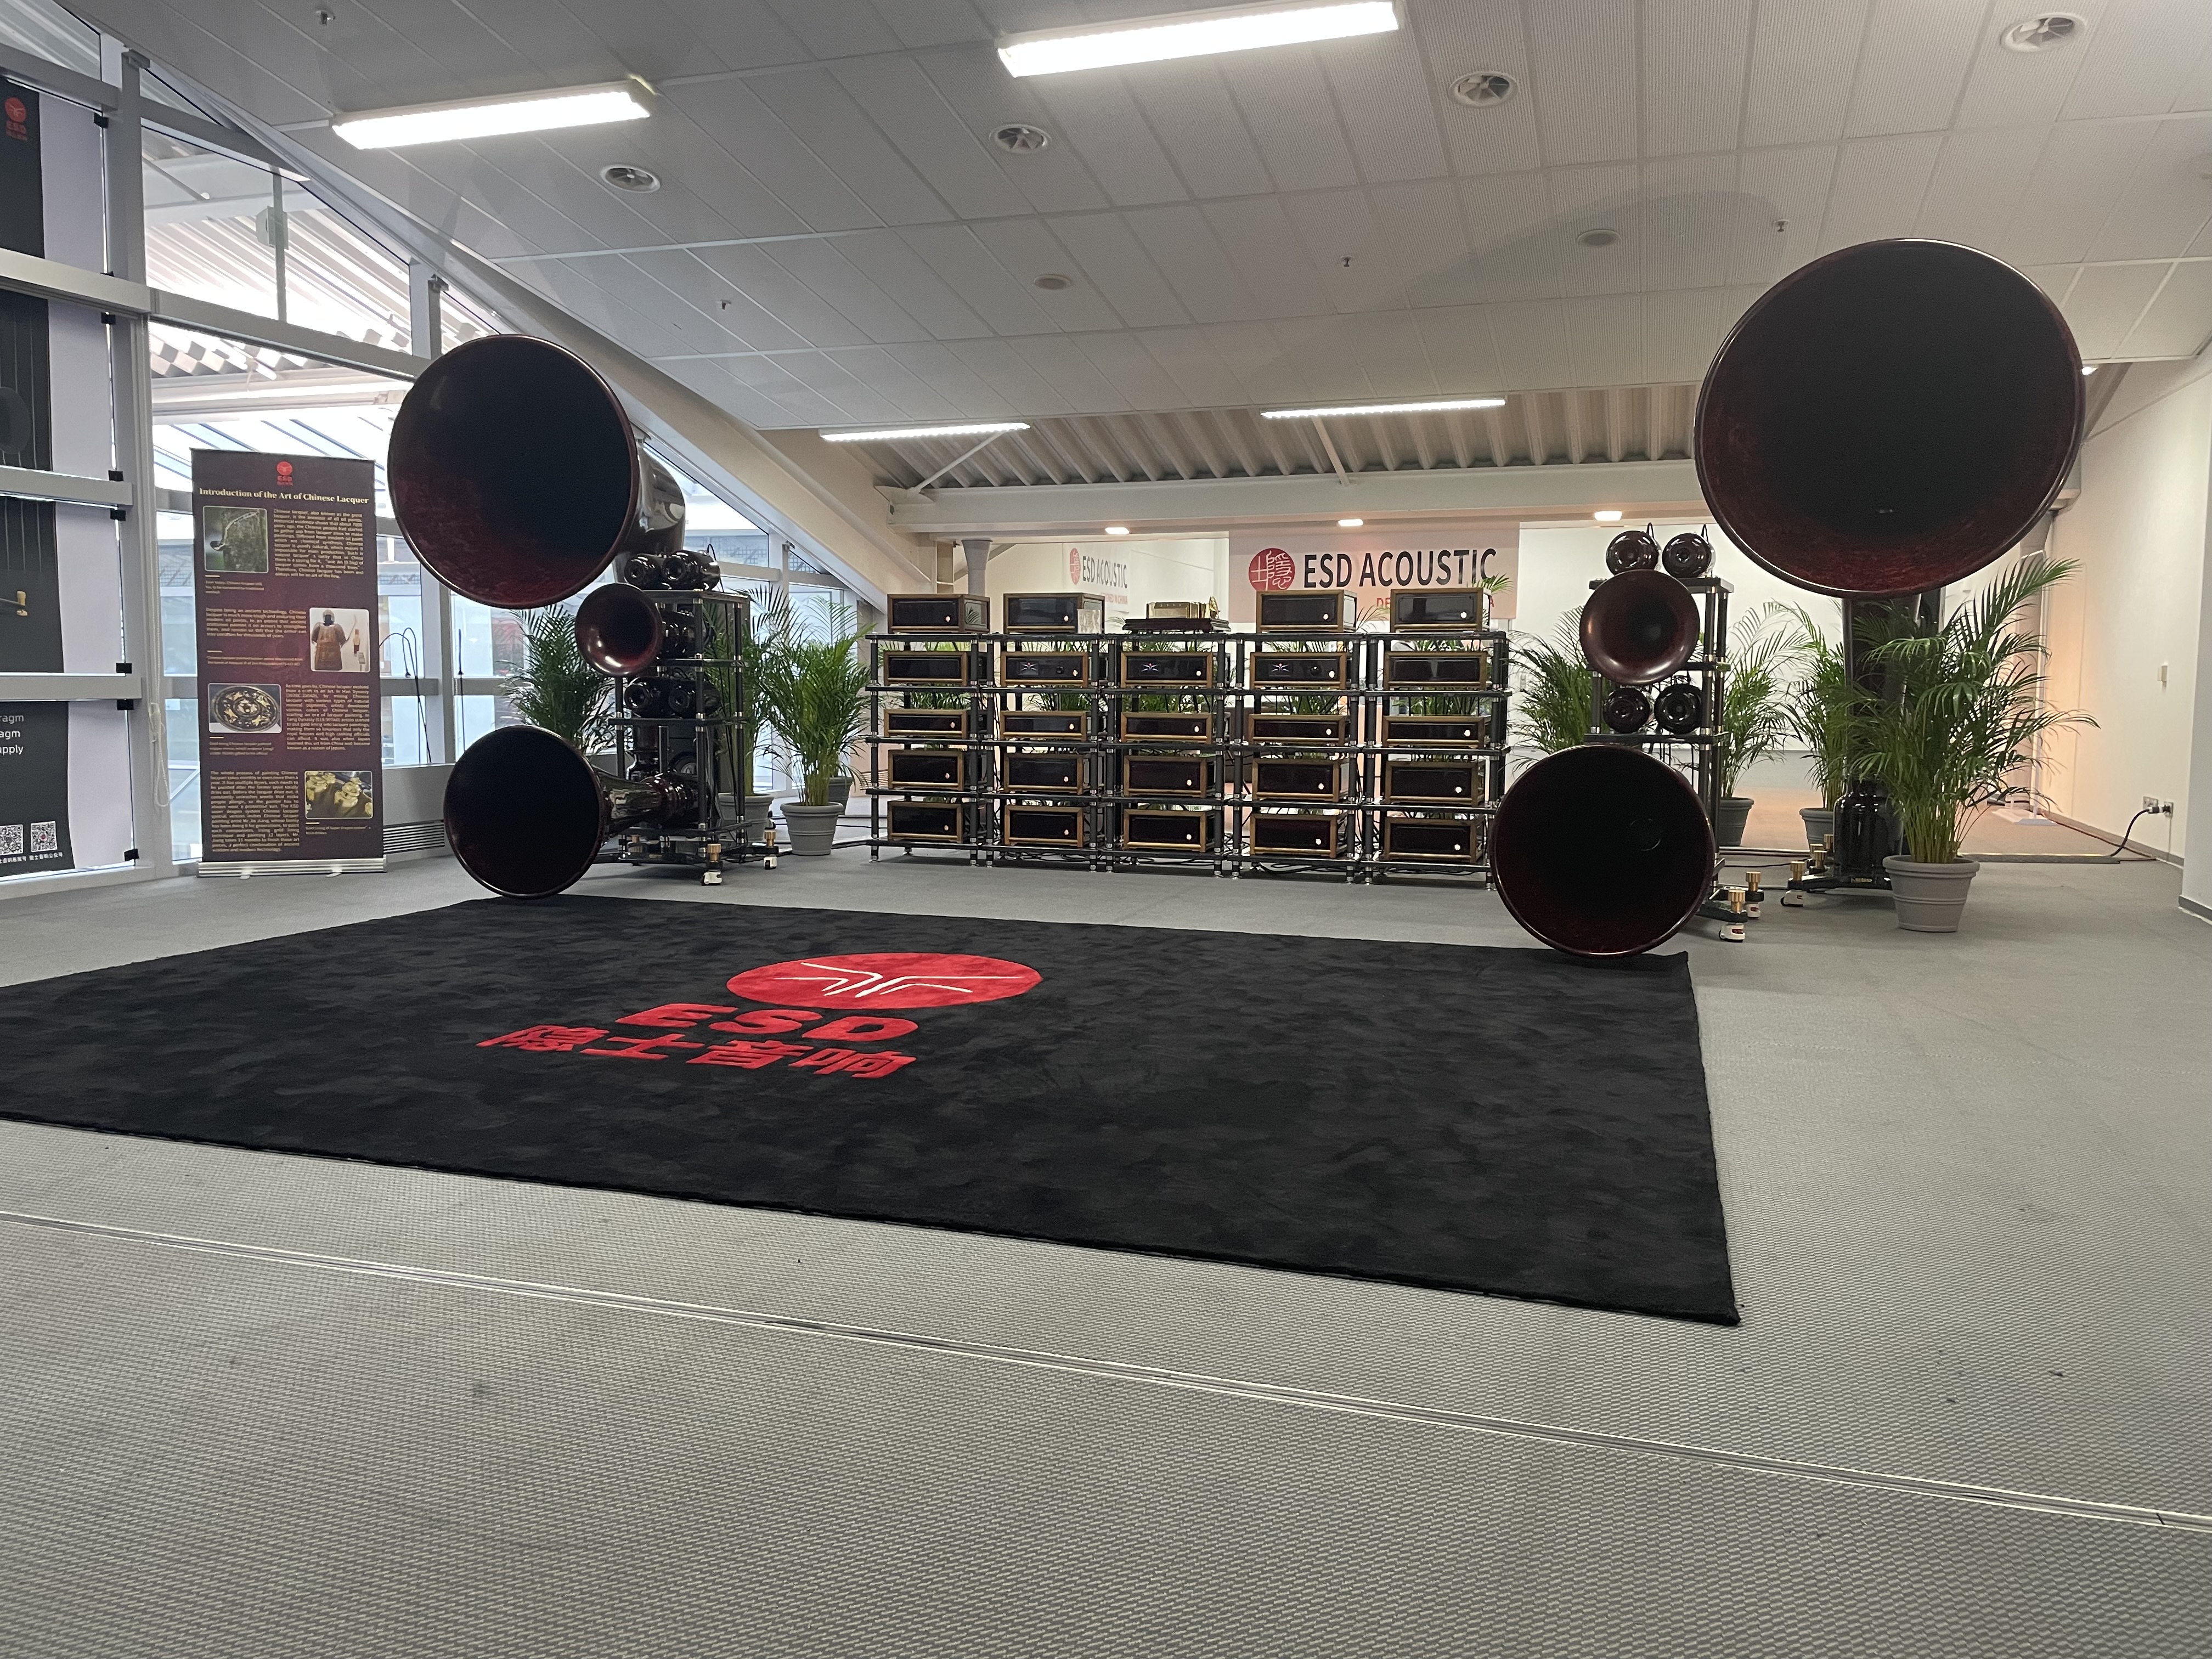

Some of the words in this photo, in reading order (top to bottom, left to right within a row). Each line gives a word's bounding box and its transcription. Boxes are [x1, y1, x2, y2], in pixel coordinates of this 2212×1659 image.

[200, 488, 252, 498] Introduction
[293, 492, 302, 500] of
[303, 493, 335, 502] Chinese
[336, 495, 369, 504] Lacquer
[1082, 556, 1095, 583] ESD
[1096, 558, 1128, 589] ACOUSTIC
[1305, 553, 1352, 589] ESD
[1359, 548, 1497, 588] ACOUSTIC
[614, 1002, 919, 1042] ESD
[475, 1024, 918, 1079] 隐士音响
